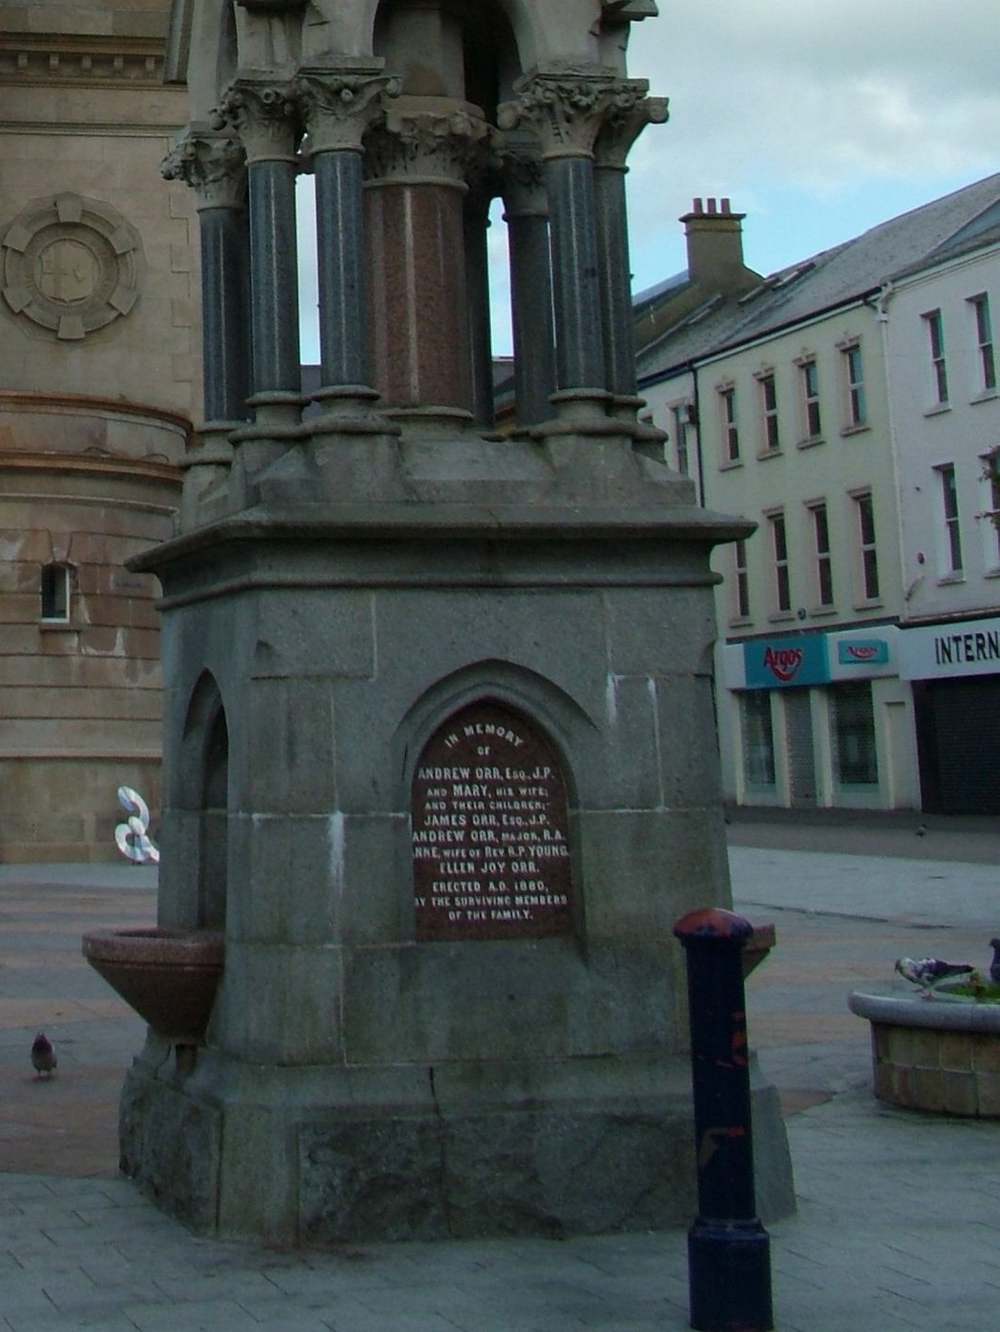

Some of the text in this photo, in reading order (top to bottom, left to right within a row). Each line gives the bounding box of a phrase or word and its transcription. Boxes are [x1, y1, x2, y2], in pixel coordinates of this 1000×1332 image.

[764, 646, 802, 672] Argos
[444, 724, 524, 748] IN MEMORY
[477, 746, 490, 756] OF
[418, 767, 470, 780] ANDREW
[427, 788, 447, 797] AND
[453, 784, 491, 798] MARY,
[496, 788, 514, 796] HIS
[425, 801, 446, 810] AND
[452, 801, 485, 810] THEIR
[424, 814, 466, 826] JAMES
[413, 830, 464, 842] ANDREW
[440, 861, 540, 874] ELLEN JOY ORR.
[433, 882, 480, 893] ERECTED
[431, 897, 450, 906] THE
[455, 897, 510, 906] SURVIVING
[515, 895, 568, 905] MEMBERS
[448, 910, 533, 920] OF THE FAMILY.
